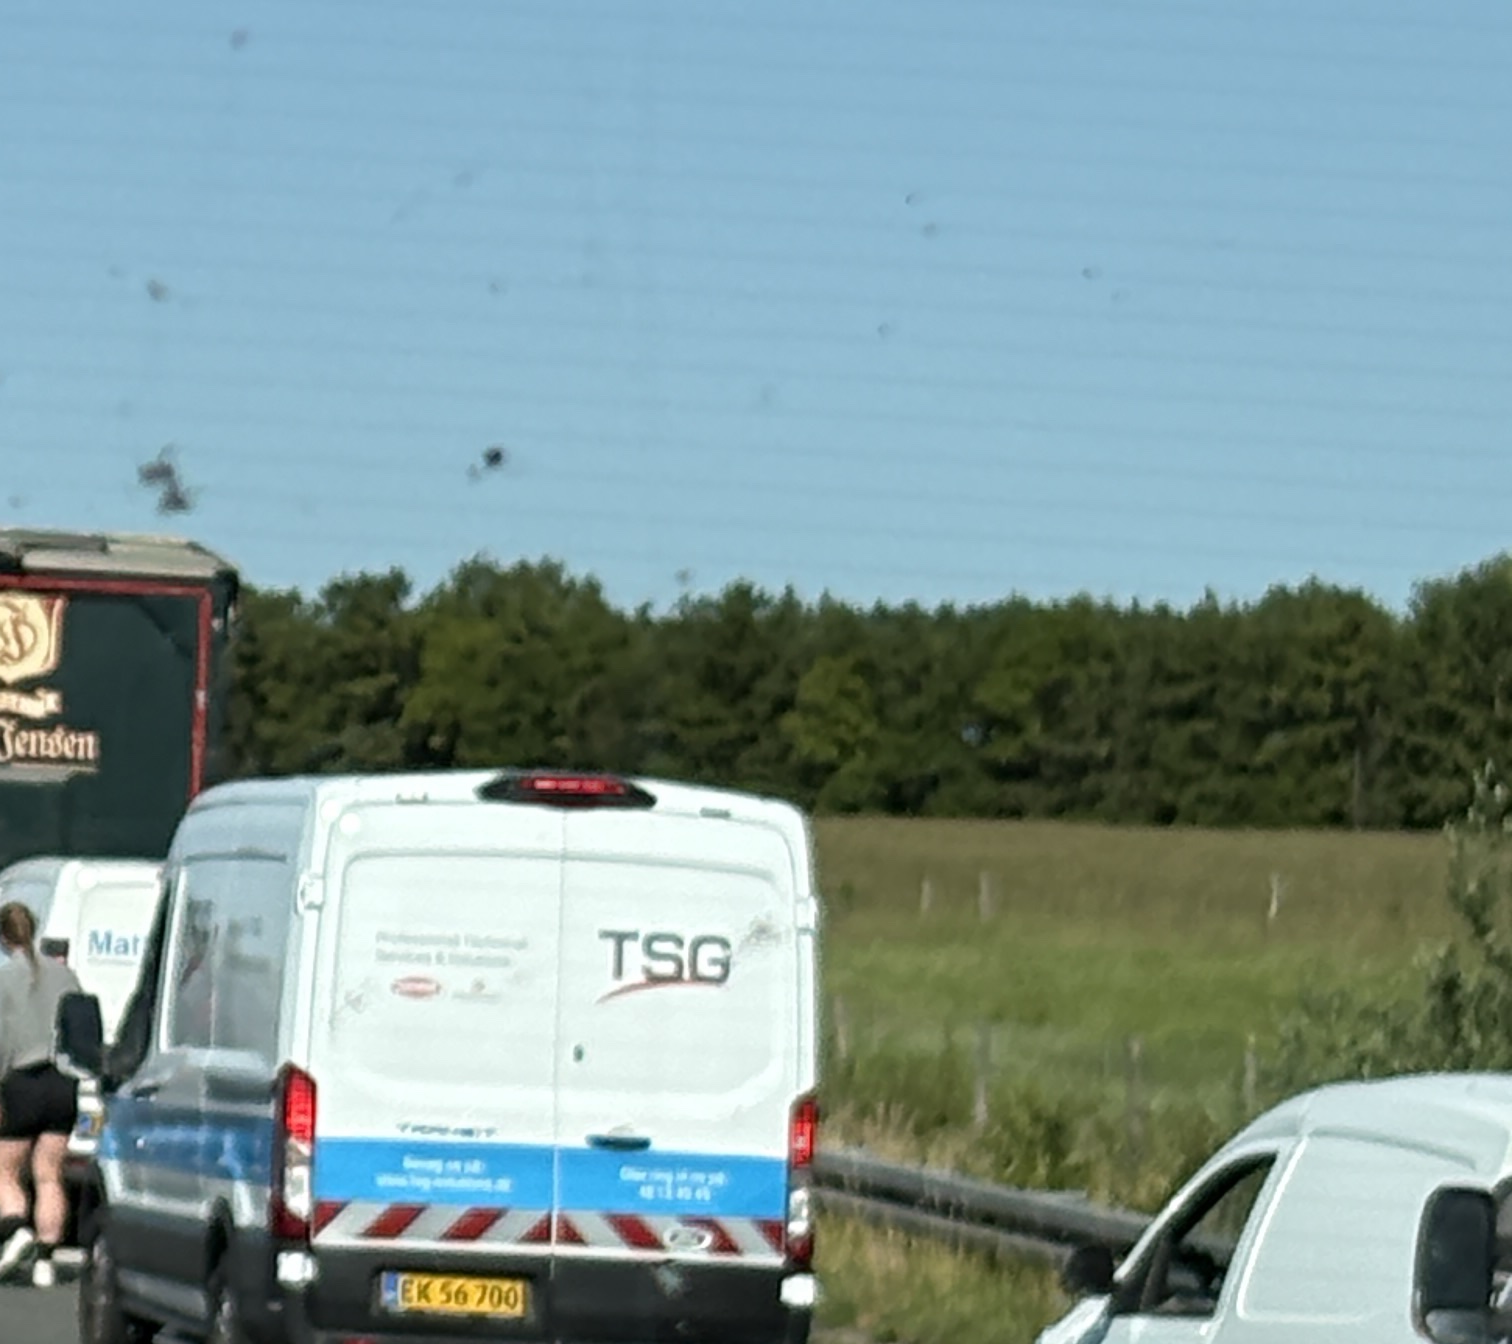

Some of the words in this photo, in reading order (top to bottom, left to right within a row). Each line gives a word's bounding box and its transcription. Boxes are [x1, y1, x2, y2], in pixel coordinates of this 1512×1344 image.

[597, 929, 731, 985] TSG
[401, 1277, 432, 1305] EK
[439, 1280, 468, 1305] 56
[474, 1283, 519, 1310] 700
